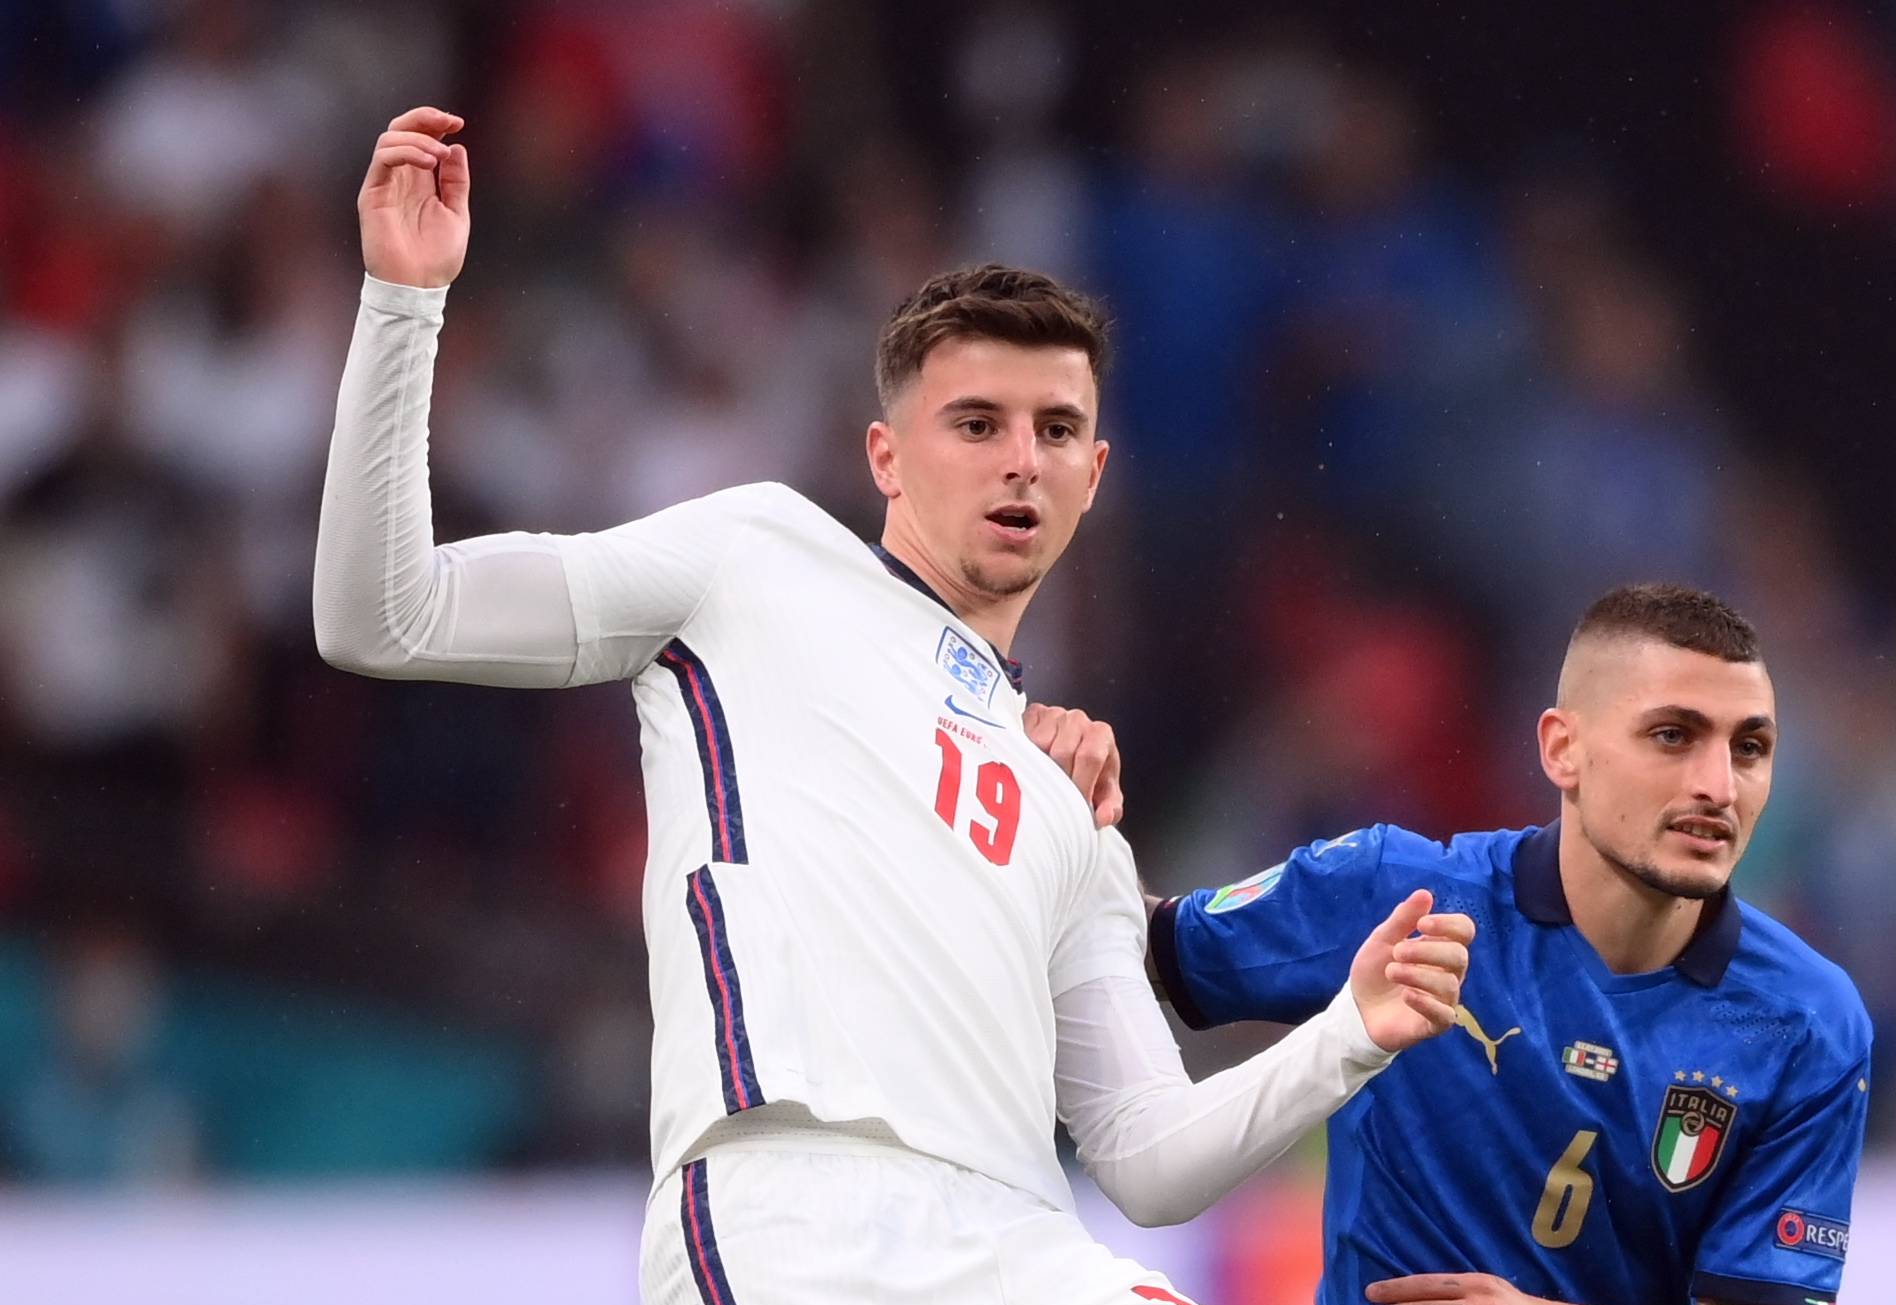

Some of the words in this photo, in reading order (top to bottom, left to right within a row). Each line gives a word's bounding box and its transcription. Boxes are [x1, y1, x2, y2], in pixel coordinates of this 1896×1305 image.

[937, 716, 958, 733] UEFA
[934, 728, 1021, 866] 19
[1669, 1093, 1728, 1122] ITALIA
[1531, 1130, 1598, 1249] 6
[1806, 1225, 1850, 1252] RESPE
